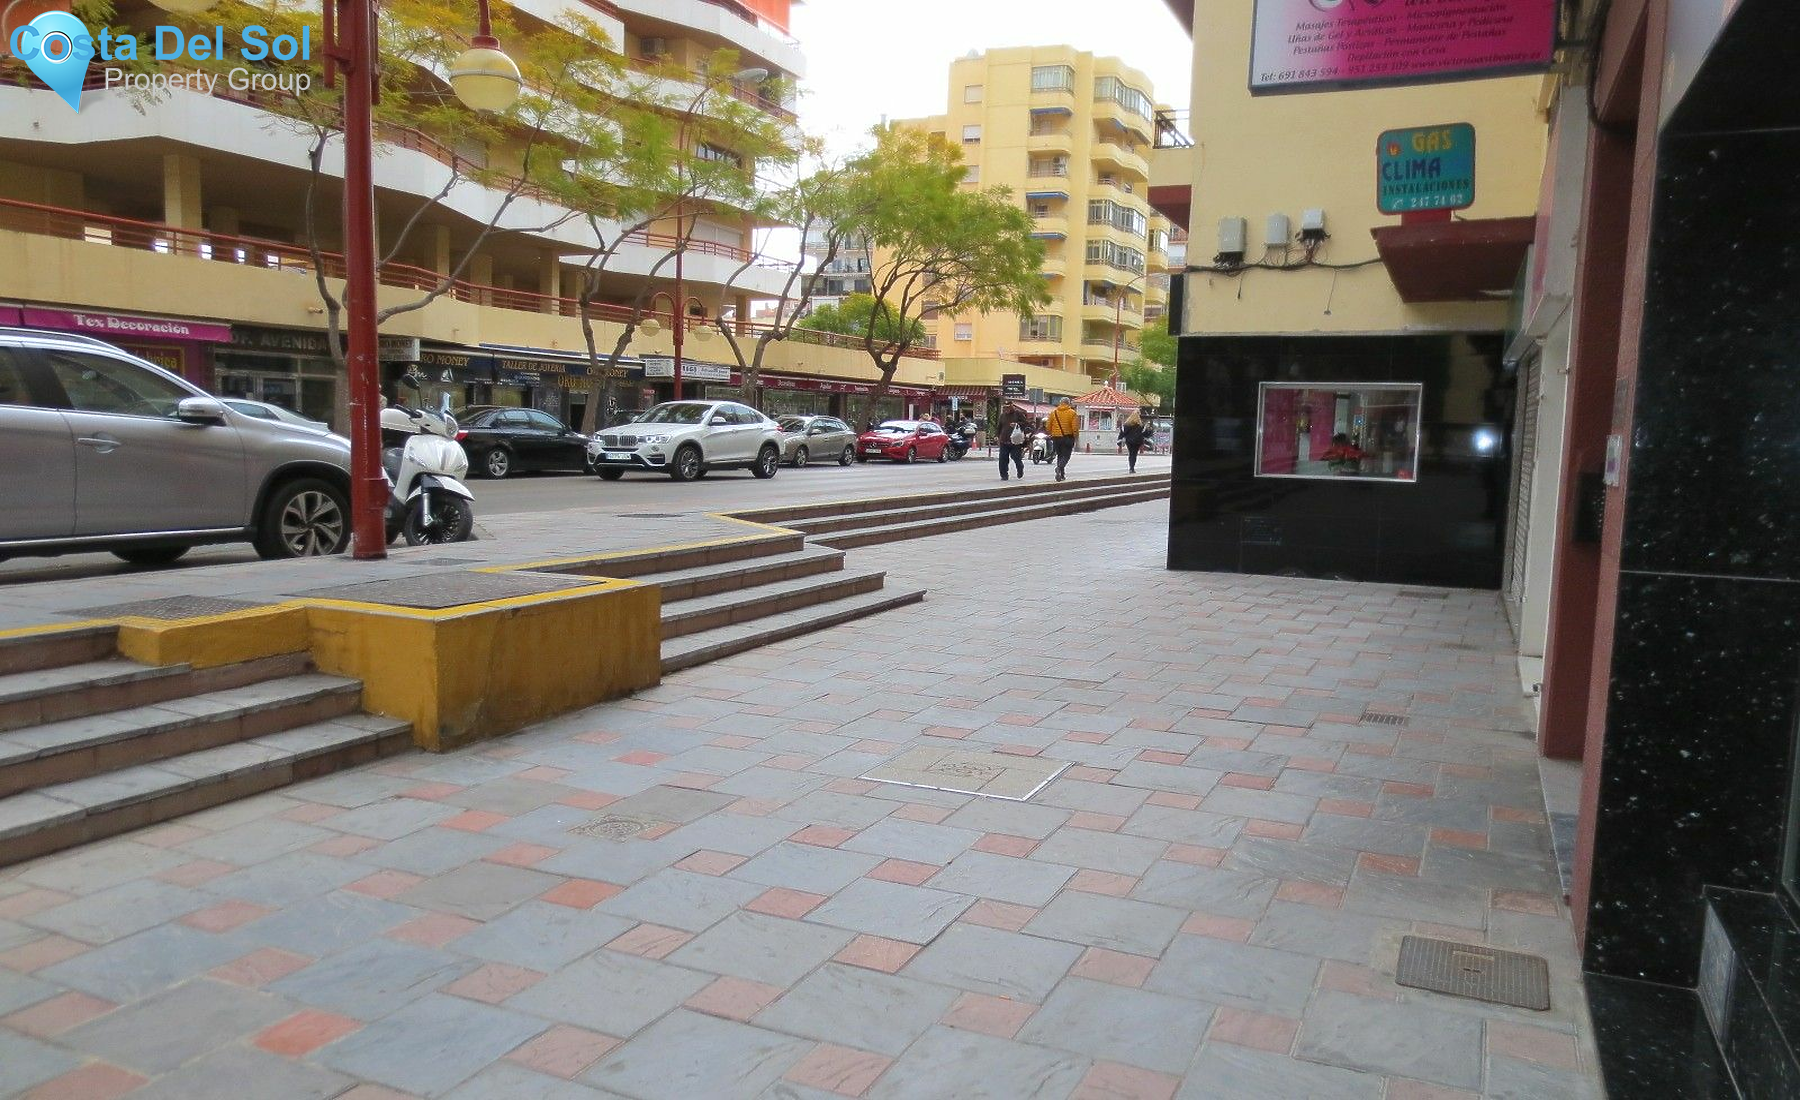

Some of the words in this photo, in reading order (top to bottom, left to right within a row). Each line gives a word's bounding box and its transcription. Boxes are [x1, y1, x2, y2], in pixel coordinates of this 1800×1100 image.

[1296, 19, 1333, 32] Masajes
[1288, 33, 1312, 43] Uñas
[1260, 71, 1277, 83] Tel:
[1278, 69, 1296, 81] 691
[1298, 67, 1318, 80] 843
[1411, 130, 1453, 153] GAS
[1382, 156, 1441, 181] CLIMA
[73, 314, 104, 328] Tex
[106, 317, 190, 336] Decoración
[436, 355, 470, 367] MONEY
[502, 360, 527, 370] TALLER
[528, 363, 538, 371] DE
